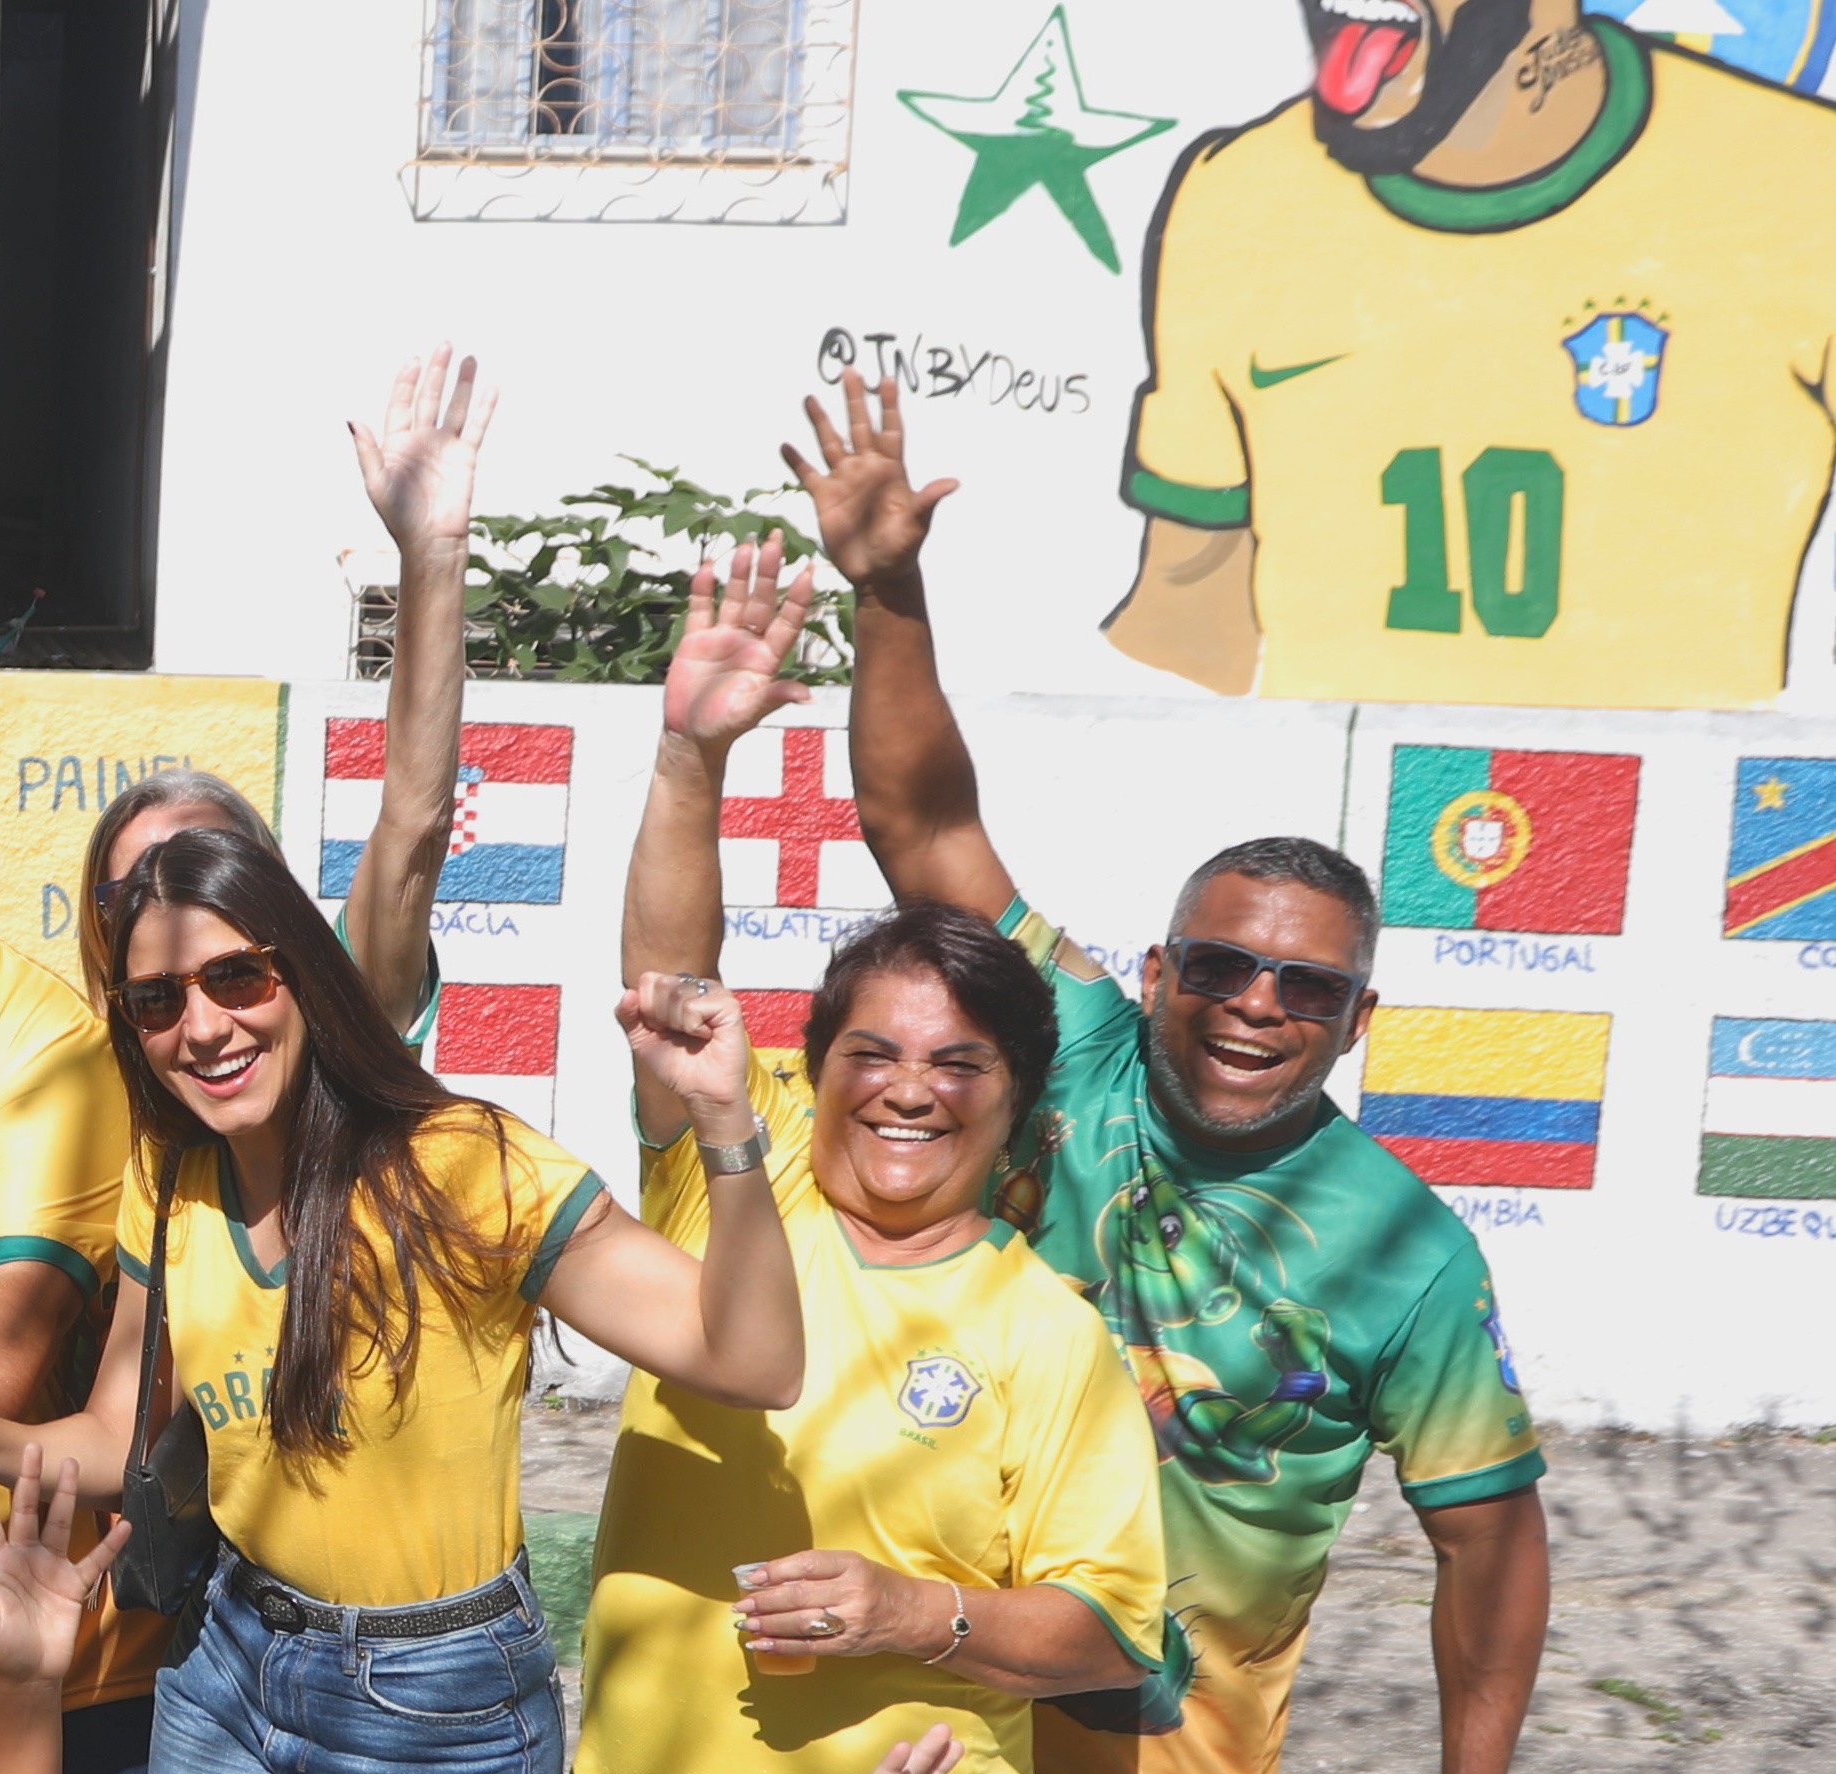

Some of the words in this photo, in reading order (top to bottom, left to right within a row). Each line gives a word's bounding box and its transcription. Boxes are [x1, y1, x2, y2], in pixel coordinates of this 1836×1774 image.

[1381, 445, 1565, 638] 10
[18, 755, 192, 812] PAIN
[41, 882, 79, 939] D
[1434, 935, 1596, 973] PORTUGAL
[898, 1427, 938, 1451] BRASIL
